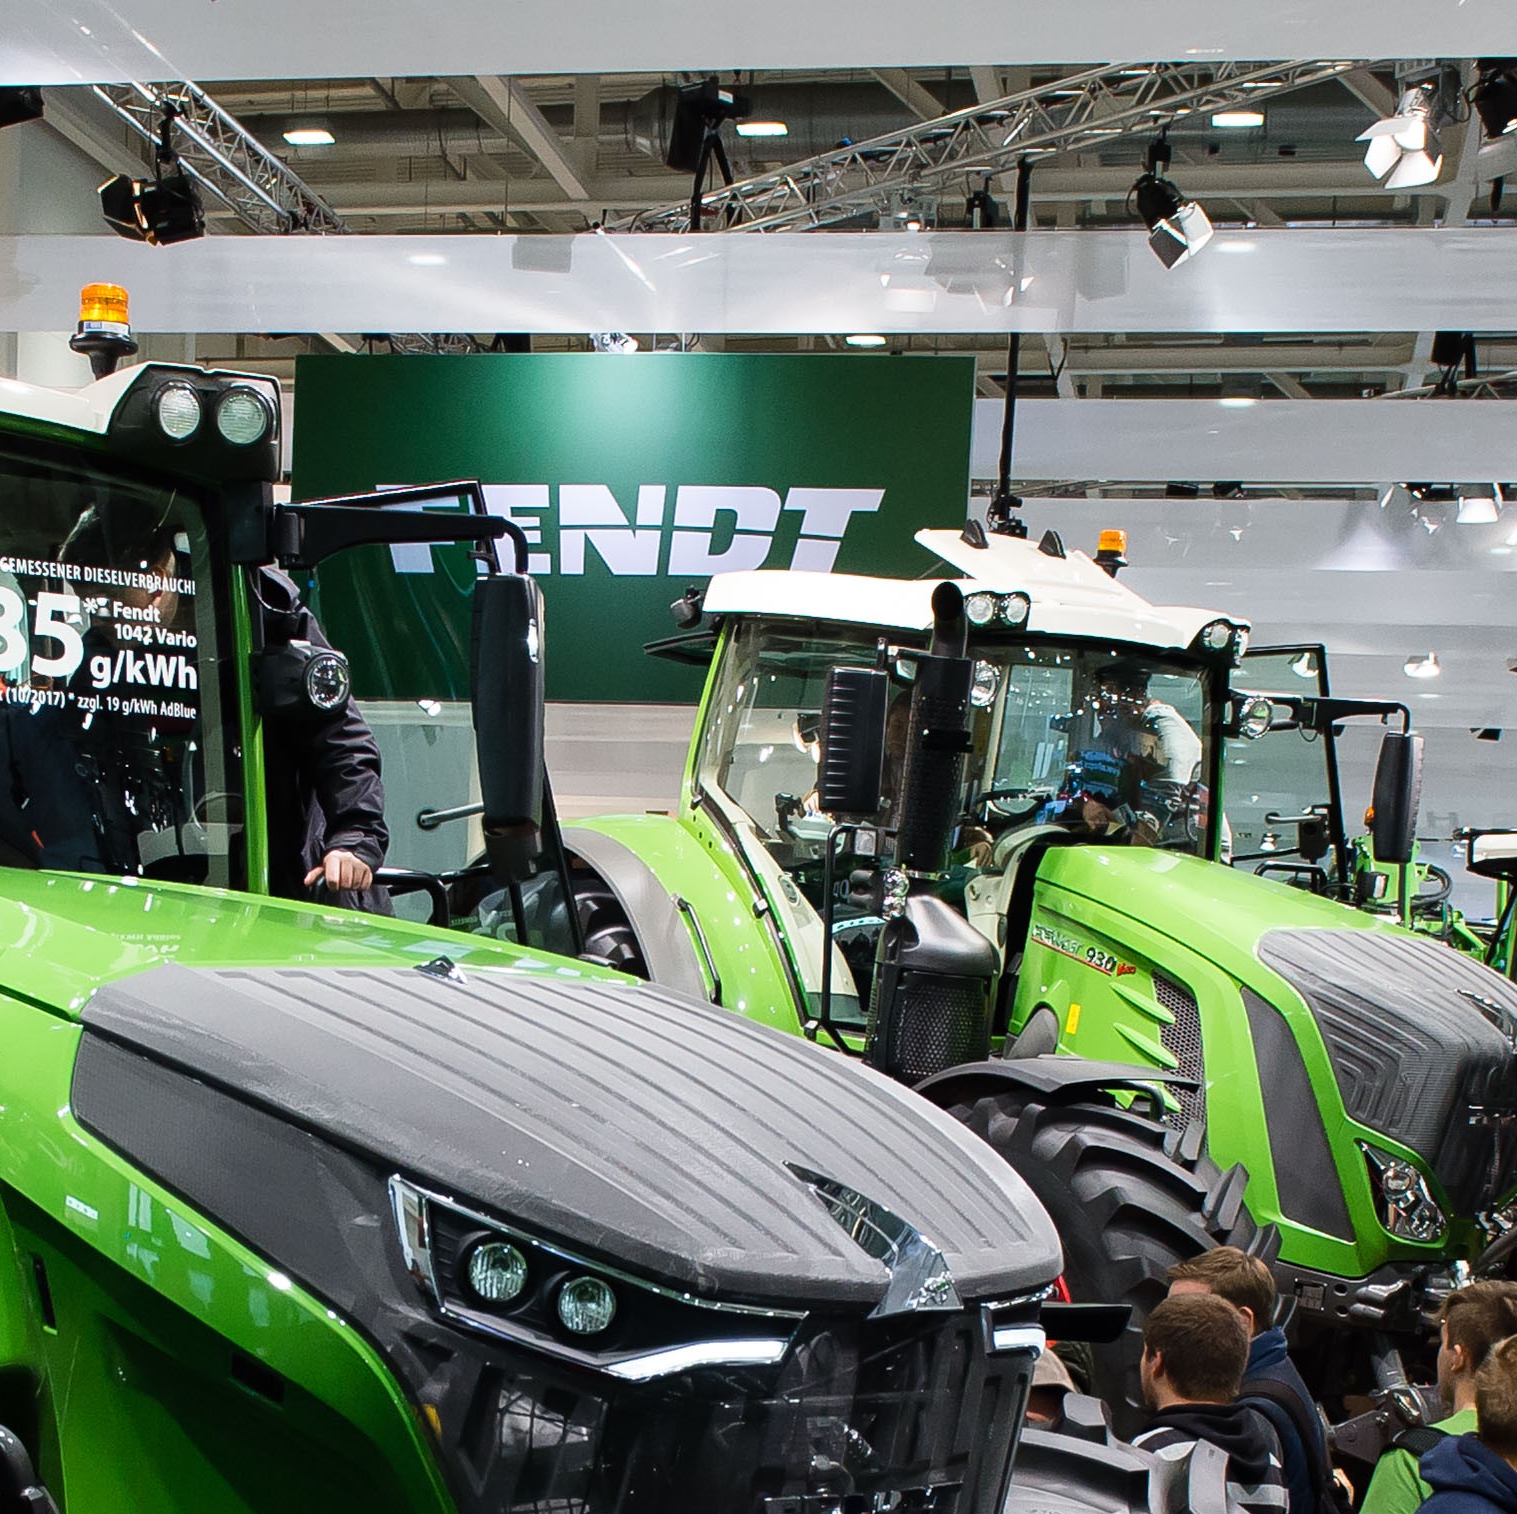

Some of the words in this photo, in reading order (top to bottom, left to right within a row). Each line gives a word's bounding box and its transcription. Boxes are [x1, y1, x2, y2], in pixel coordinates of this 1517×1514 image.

[0, 556, 82, 581] GEMESSENER
[84, 567, 197, 595] DIESELVERBRAUCH!
[113, 601, 161, 623] Fendt
[114, 624, 153, 644] 1042
[156, 627, 198, 648] Vario
[90, 650, 198, 690] g/kWh
[6, 686, 66, 708] (10/2017)
[77, 695, 103, 713] zzgl.
[106, 697, 120, 711] 19
[122, 698, 158, 717] g/kWh
[160, 703, 197, 720] AdBlue
[1086, 946, 1117, 973] 930
